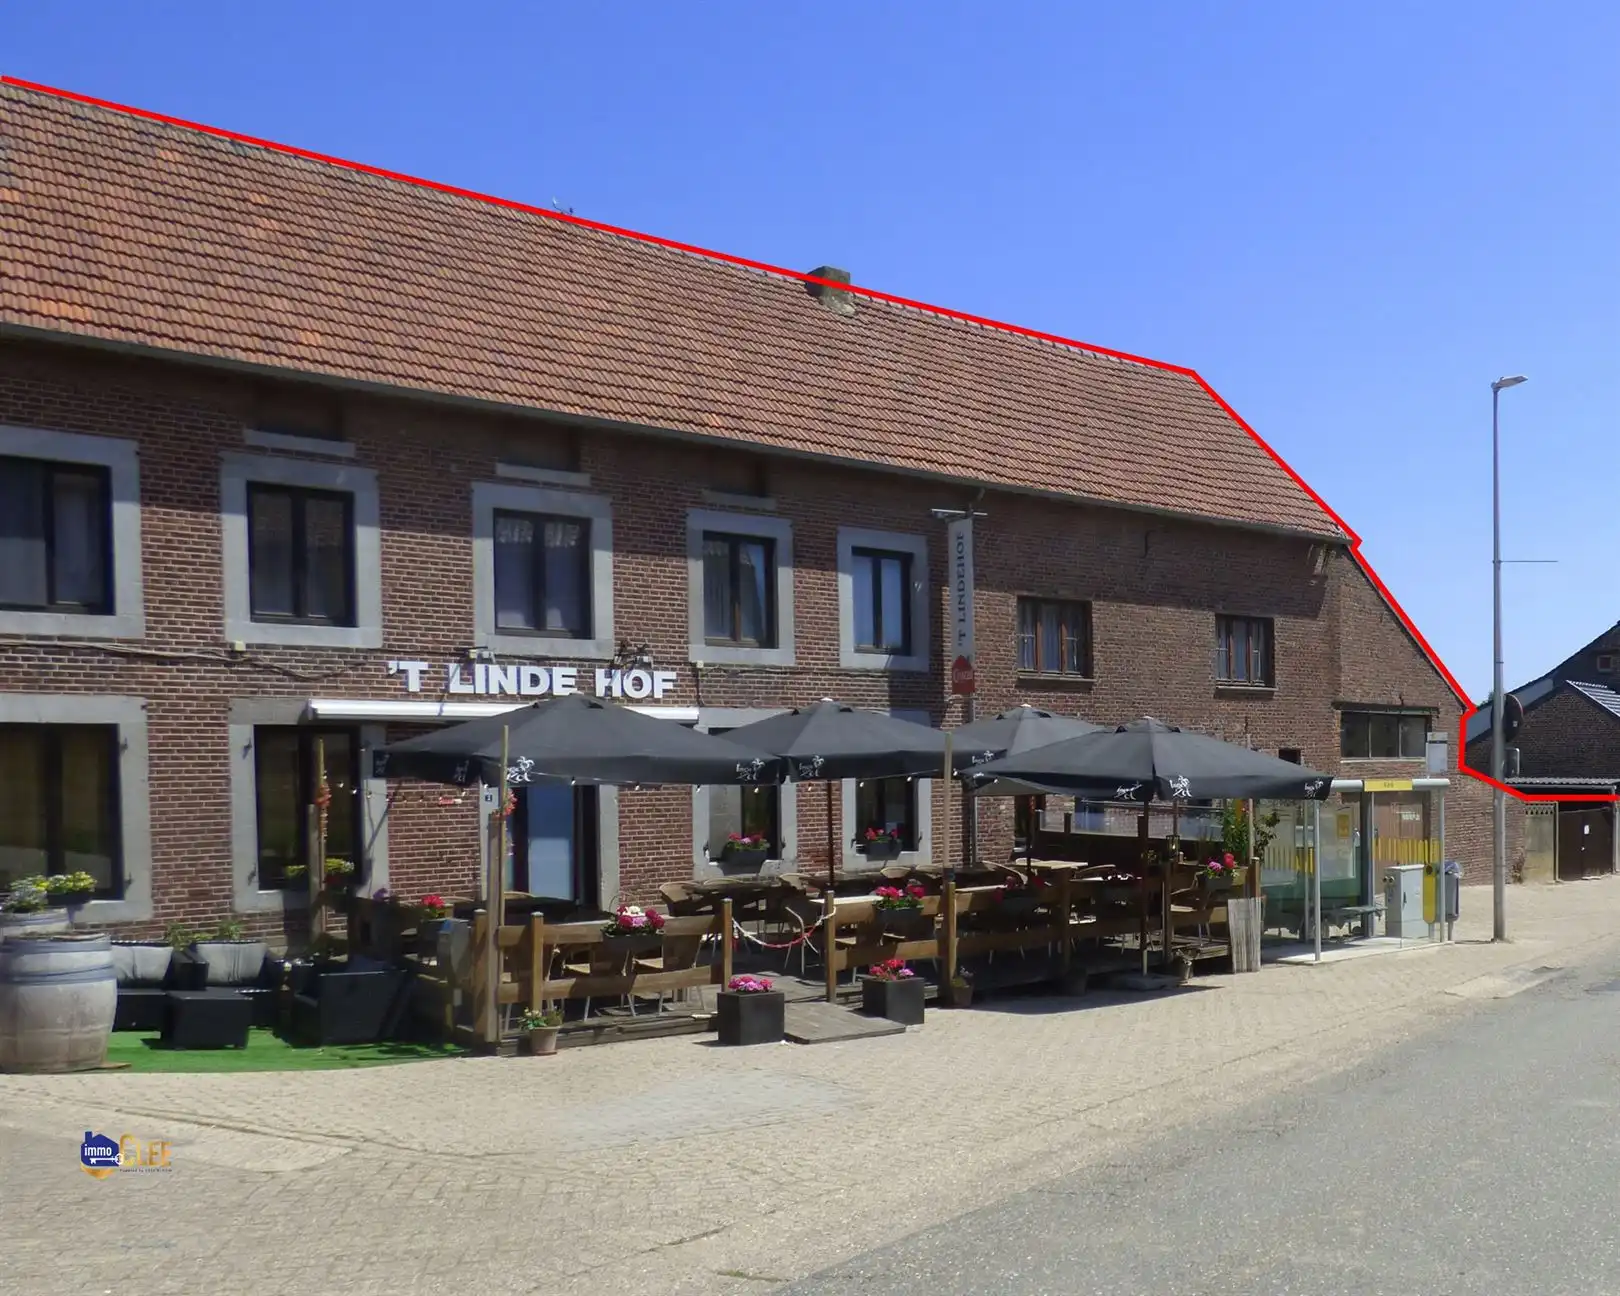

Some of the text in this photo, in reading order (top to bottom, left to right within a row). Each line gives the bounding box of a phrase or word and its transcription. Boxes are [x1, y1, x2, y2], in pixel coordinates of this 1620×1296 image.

[388, 660, 678, 699] 'T LINDE HOF
